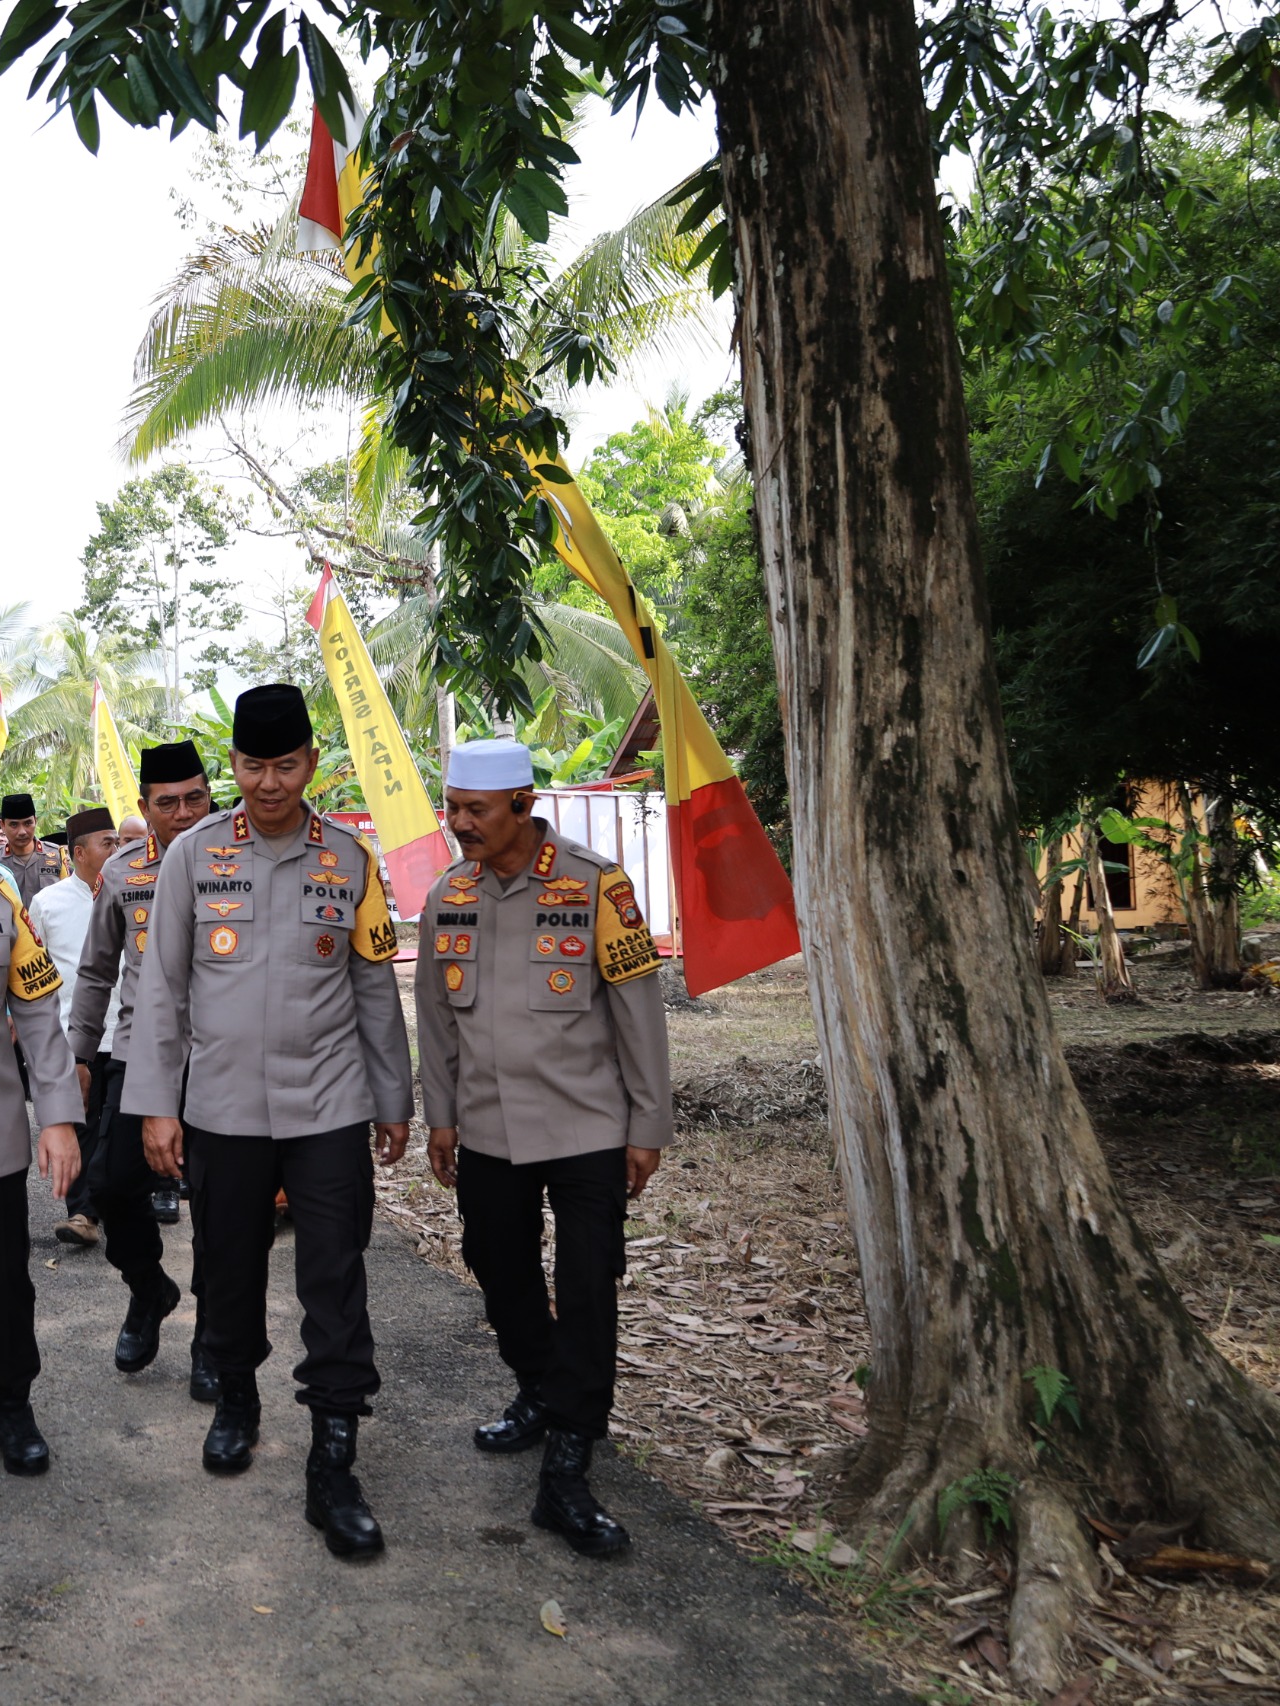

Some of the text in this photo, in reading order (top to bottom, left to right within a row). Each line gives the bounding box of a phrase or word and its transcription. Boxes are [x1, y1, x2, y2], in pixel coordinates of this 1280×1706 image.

[197, 880, 253, 894] WINARTO
[303, 885, 354, 902] POLRI
[536, 912, 589, 928] POLRI
